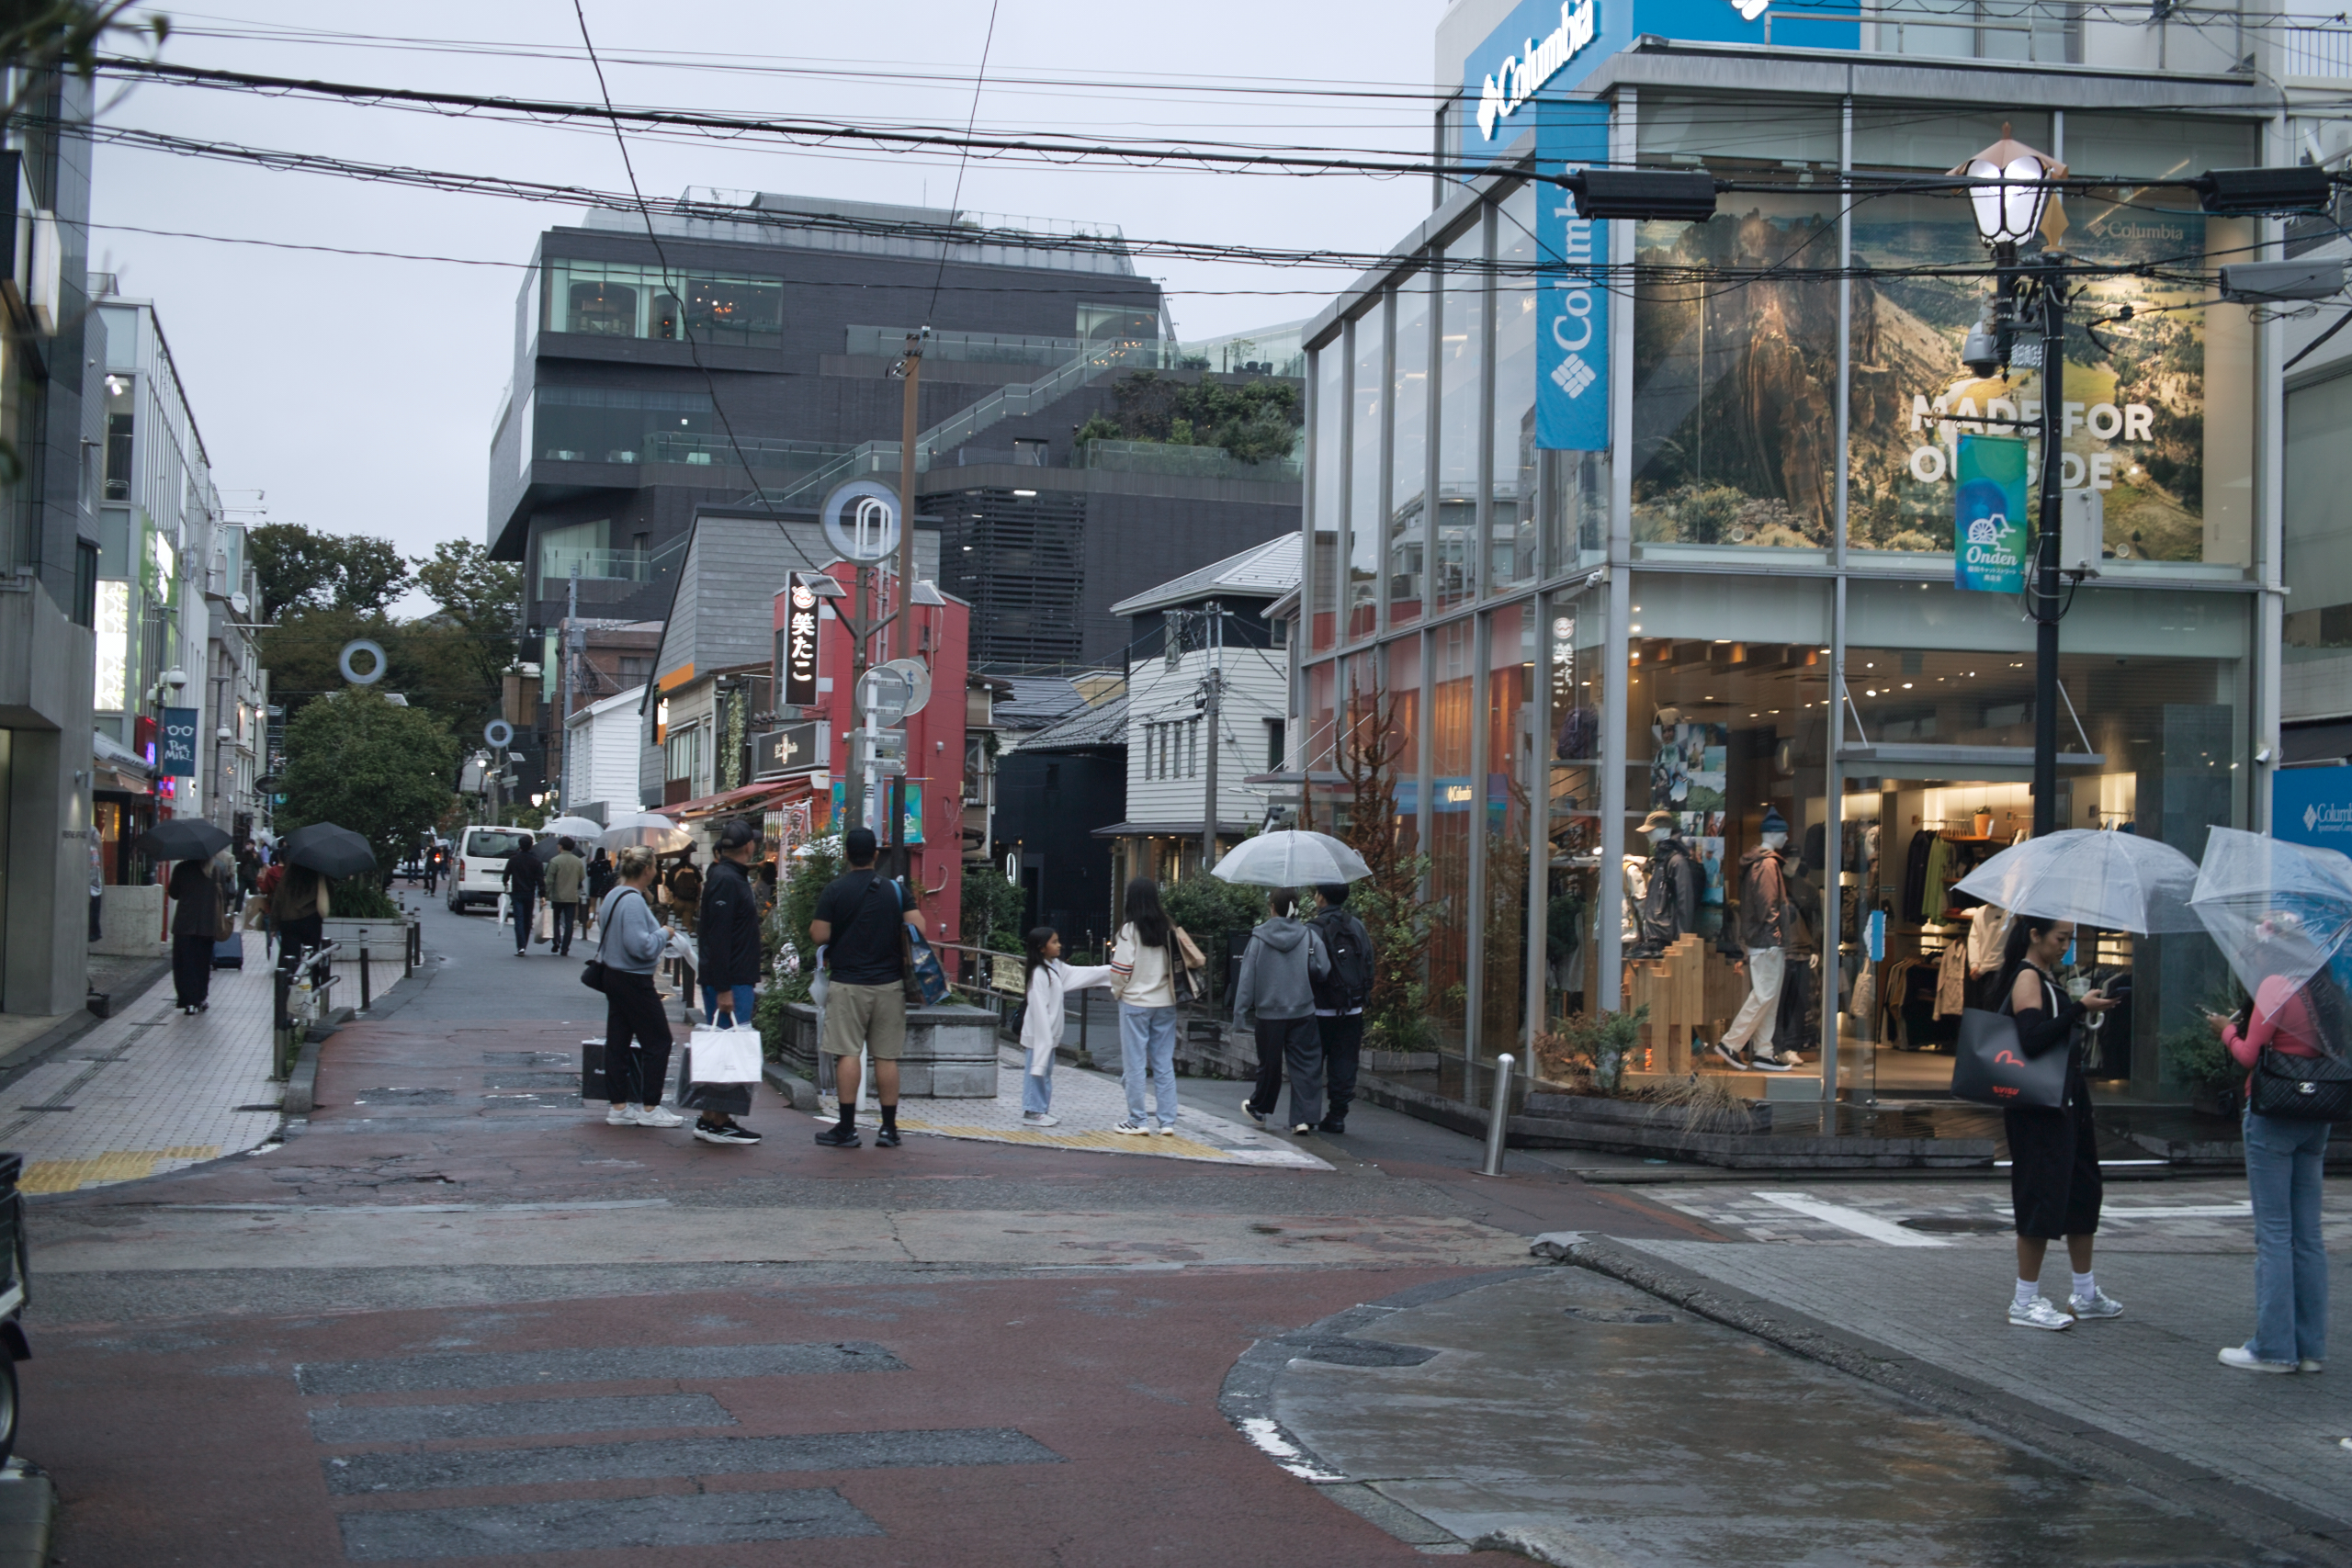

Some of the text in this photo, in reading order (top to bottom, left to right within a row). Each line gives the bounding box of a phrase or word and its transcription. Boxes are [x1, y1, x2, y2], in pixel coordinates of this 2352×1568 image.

[1497, 0, 1594, 118] Columbia
[2108, 220, 2184, 240] Columbia
[1910, 394, 2154, 441] MADE FOR
[1966, 546, 2018, 566] Onden
[791, 612, 816, 682] 笑たこ
